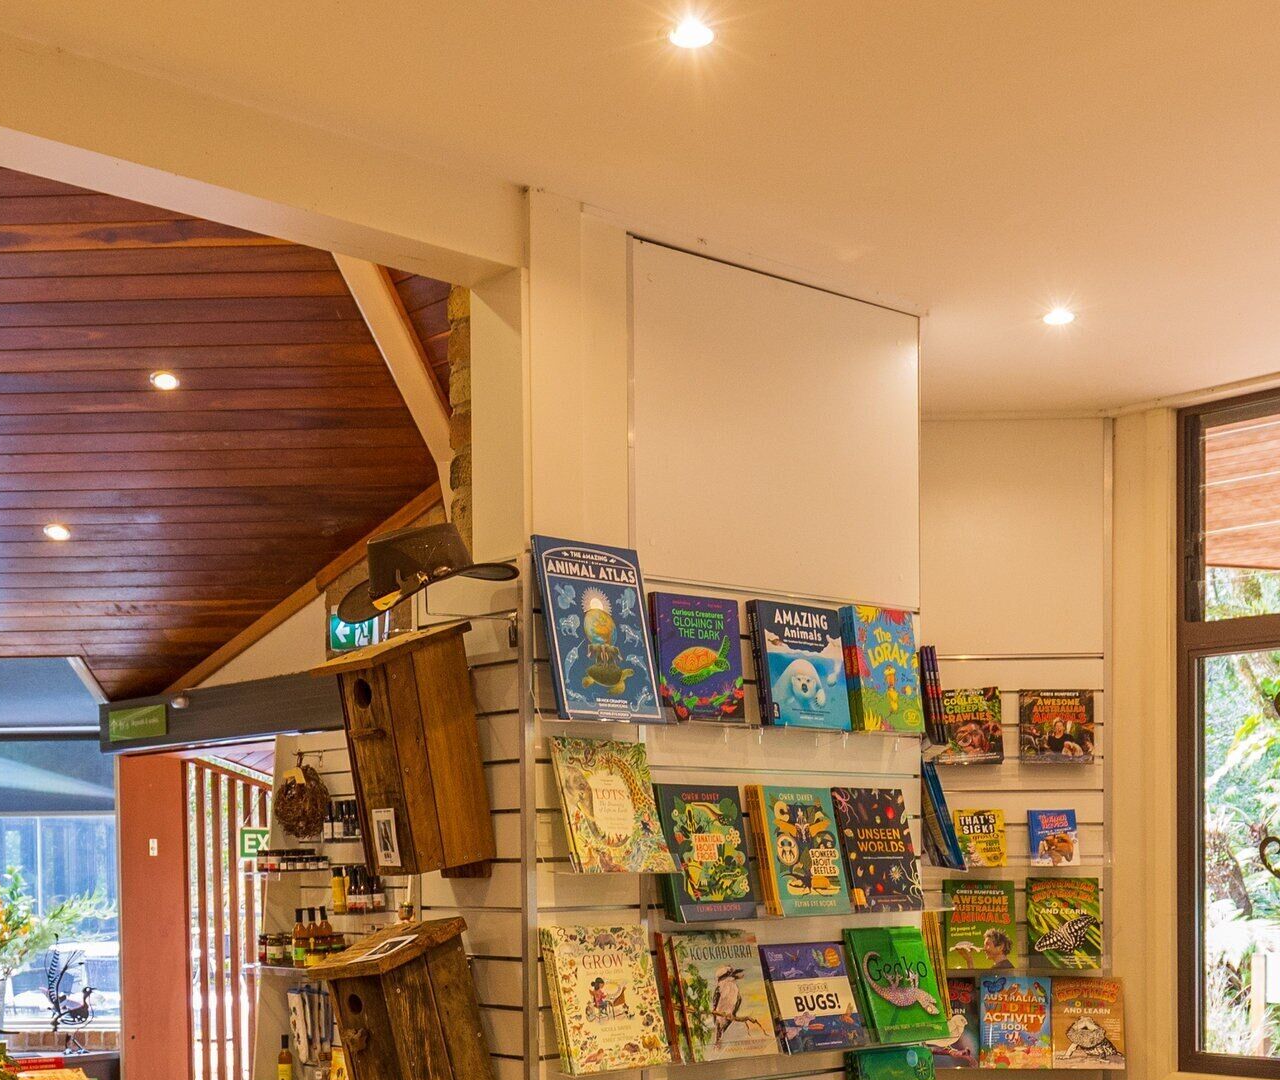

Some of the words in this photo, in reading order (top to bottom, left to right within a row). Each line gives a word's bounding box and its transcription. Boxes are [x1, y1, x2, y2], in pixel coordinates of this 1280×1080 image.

[582, 553, 608, 562] AMAZING
[547, 559, 596, 578] ANIMAL
[599, 566, 636, 584] ATLAS
[672, 608, 694, 617] Curious
[695, 609, 723, 620] Creatures
[774, 608, 828, 631] AMAZING
[673, 616, 712, 629] GLOWING
[715, 620, 723, 630] IN
[678, 628, 695, 638] THE
[698, 629, 720, 640] DARK
[784, 627, 822, 641] Animals
[874, 627, 892, 643] The
[868, 641, 910, 669] LORAX
[1036, 698, 1080, 706] AWESOME
[1032, 705, 1086, 713] AUSTRALIAN
[594, 788, 625, 800] LOTS
[960, 815, 995, 826] THAT'S
[857, 828, 900, 840] UNSEEN
[963, 824, 994, 835] SICK!
[696, 843, 716, 851] ABOUT
[857, 841, 906, 853] WORLDS
[696, 851, 717, 860] FROGS
[810, 850, 837, 858] BONKERS
[812, 859, 832, 867] ABOUT
[813, 866, 837, 875] BEETLES
[951, 896, 1008, 904] AWESOME
[954, 905, 1008, 913] AUSTRALIAN
[951, 912, 1011, 925] ANIMALS
[690, 945, 752, 960] KOOKABURRA
[582, 954, 623, 970] GROW
[867, 955, 928, 982] Gecko
[793, 993, 841, 1012] BUGS!
[983, 993, 1045, 1003] AUSTRALIAN
[983, 1012, 1045, 1024] ACTIVITY
[1000, 1023, 1028, 1031] BOOK
